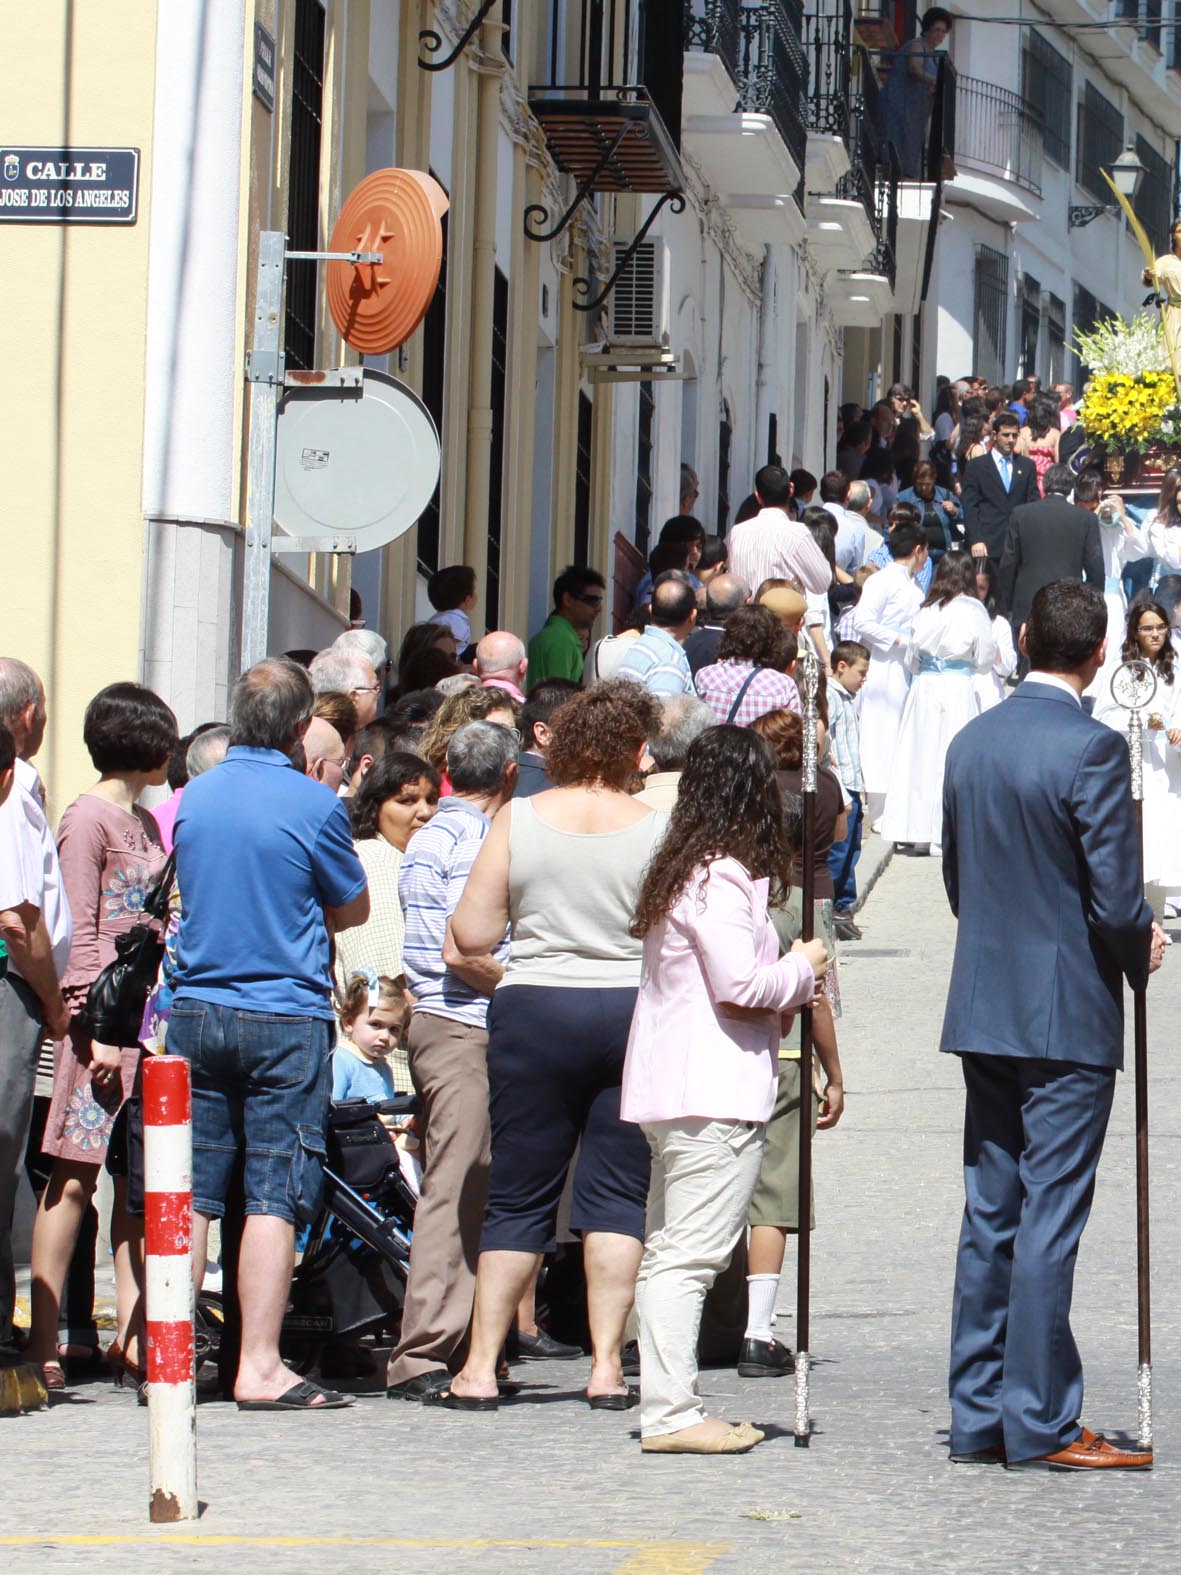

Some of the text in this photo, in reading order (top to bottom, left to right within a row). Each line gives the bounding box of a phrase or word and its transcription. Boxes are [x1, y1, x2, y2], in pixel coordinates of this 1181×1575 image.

[26, 161, 107, 181] CALLE
[0, 189, 130, 208] JOSE DE LOS ANGELES
